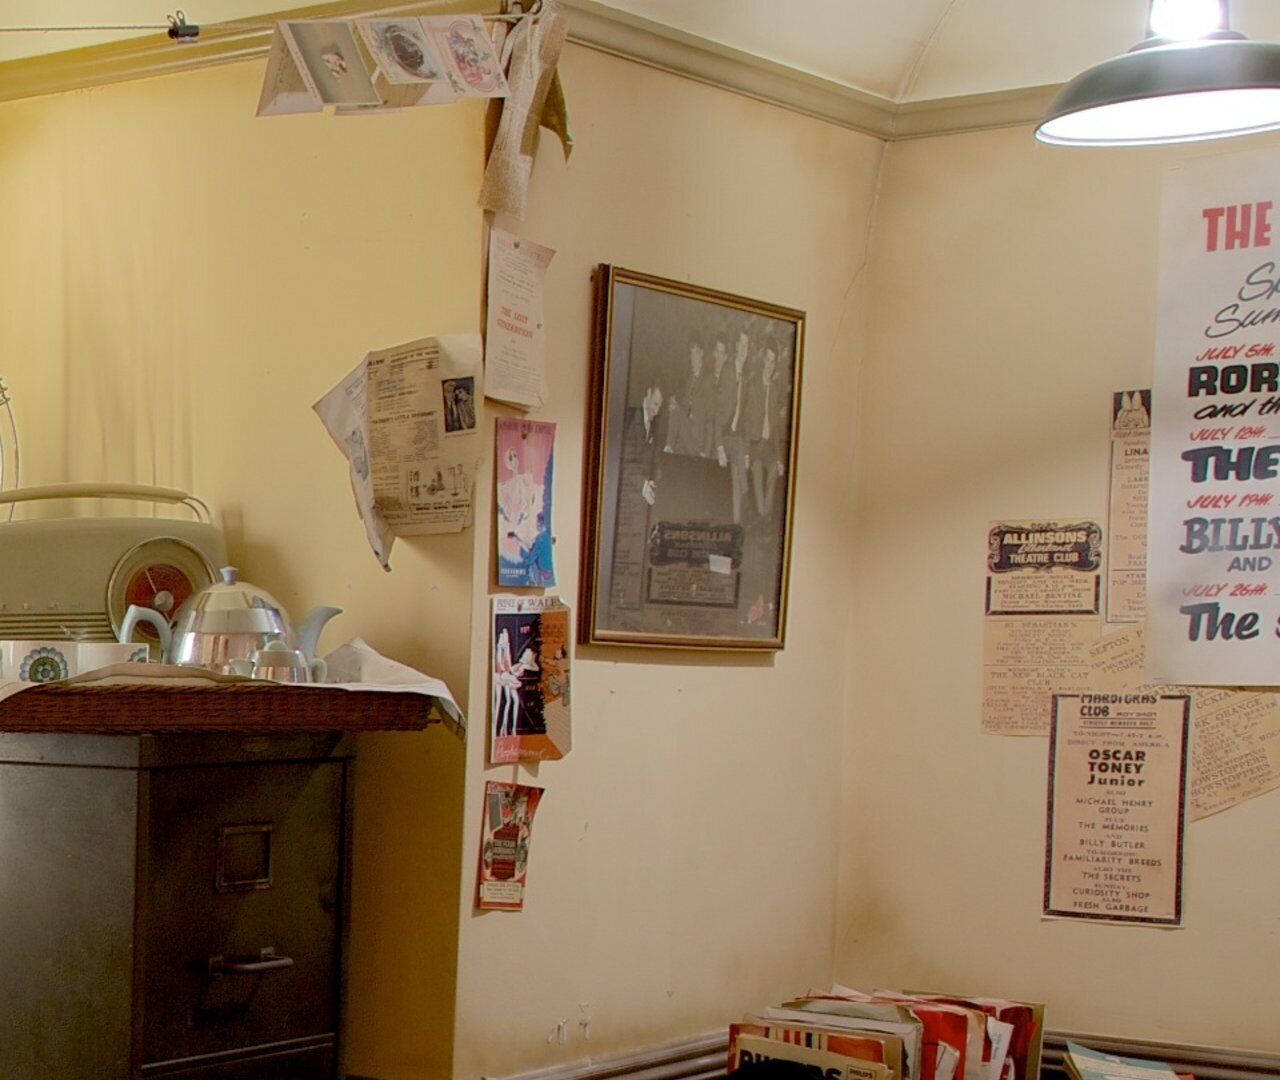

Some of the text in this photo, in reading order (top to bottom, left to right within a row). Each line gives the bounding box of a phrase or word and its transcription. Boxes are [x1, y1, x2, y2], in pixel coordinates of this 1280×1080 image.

[1202, 201, 1272, 252] THE
[1195, 344, 1244, 362] JULY
[1194, 399, 1256, 420] and
[1190, 427, 1232, 441] JULY
[1181, 444, 1280, 484] THE
[1187, 494, 1237, 509] JULY
[1003, 531, 1087, 544] ALLINSONS
[1009, 552, 1079, 563] THEATRE CLUB
[1227, 556, 1273, 573] AND
[1183, 584, 1231, 597] JULY
[1179, 602, 1260, 642] The
[1080, 705, 1110, 717] CLUB
[1089, 749, 1146, 761] OSCAR
[1088, 762, 1144, 774] TONEY
[1088, 774, 1145, 787] Junior
[1122, 800, 1154, 808] HENRY
[1063, 854, 1122, 864] FAMILIARITY
[1072, 888, 1151, 899] CURIOSITY SHOP
[1073, 901, 1149, 913] FRESH GARBAGE
[849, 1068, 874, 1079] PHILIPS
